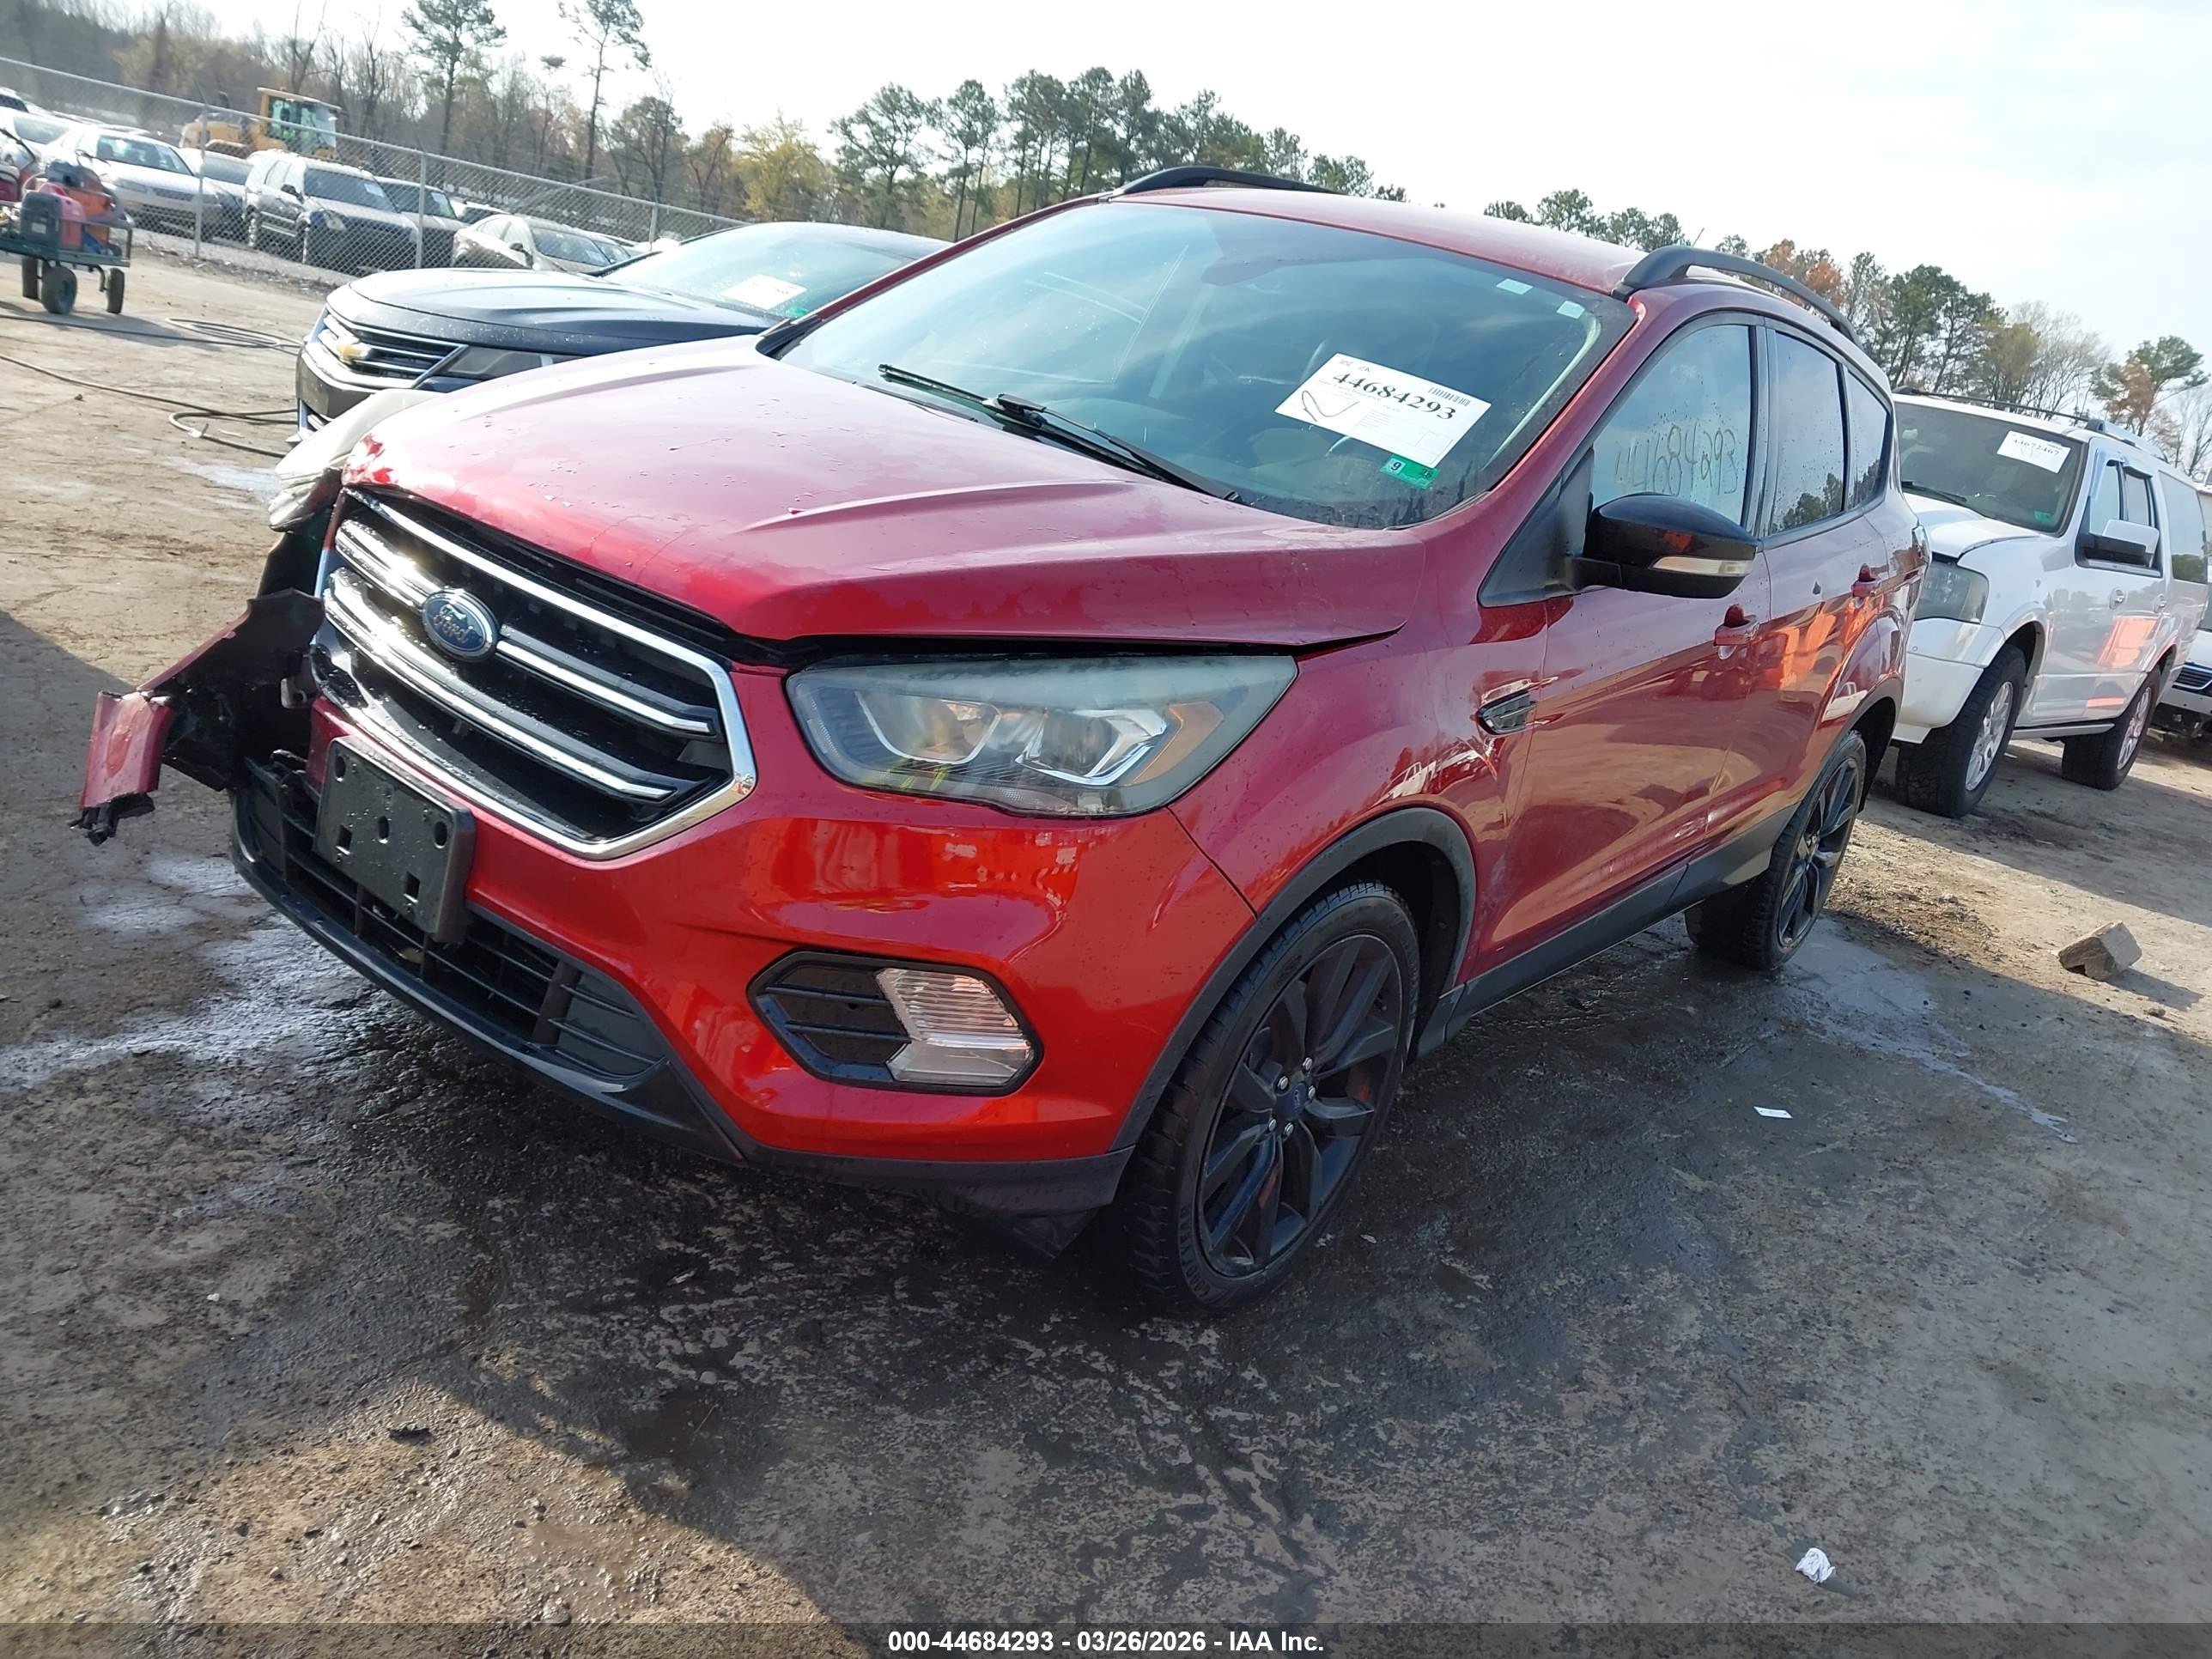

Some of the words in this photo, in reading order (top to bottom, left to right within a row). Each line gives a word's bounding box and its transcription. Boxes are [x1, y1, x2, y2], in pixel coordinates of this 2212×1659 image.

[1332, 373, 1457, 420] 44684293
[1390, 461, 1402, 471] 9
[432, 604, 474, 644] Ford
